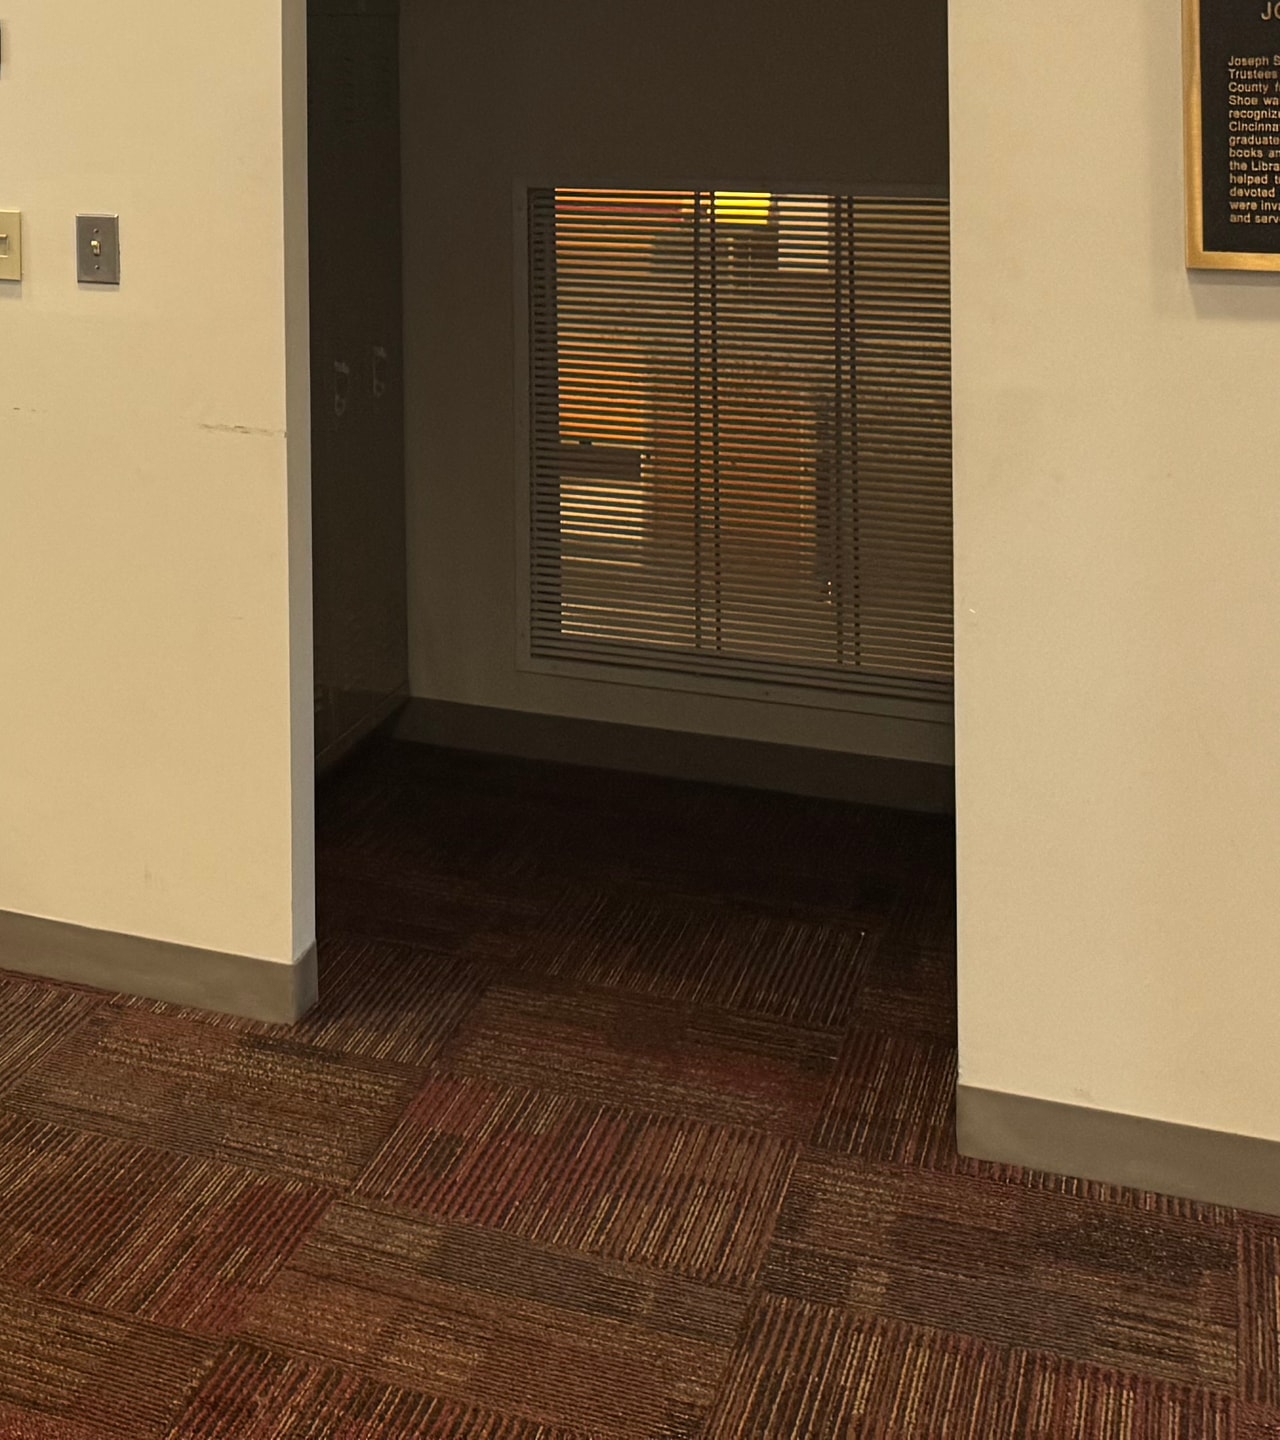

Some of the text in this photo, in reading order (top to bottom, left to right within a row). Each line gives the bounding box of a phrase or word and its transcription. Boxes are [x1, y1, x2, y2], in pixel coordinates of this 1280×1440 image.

[1228, 55, 1269, 68] Joseph
[1228, 68, 1278, 79] Trustees
[1228, 81, 1269, 95] County
[1228, 95, 1258, 106] Shoe
[1228, 121, 1280, 132] Cincinna
[1229, 147, 1263, 158] books
[1229, 160, 1248, 171] the
[1229, 173, 1268, 186] helped
[1229, 186, 1276, 198] devoted
[1228, 201, 1258, 211] were
[1229, 213, 1251, 223] and
